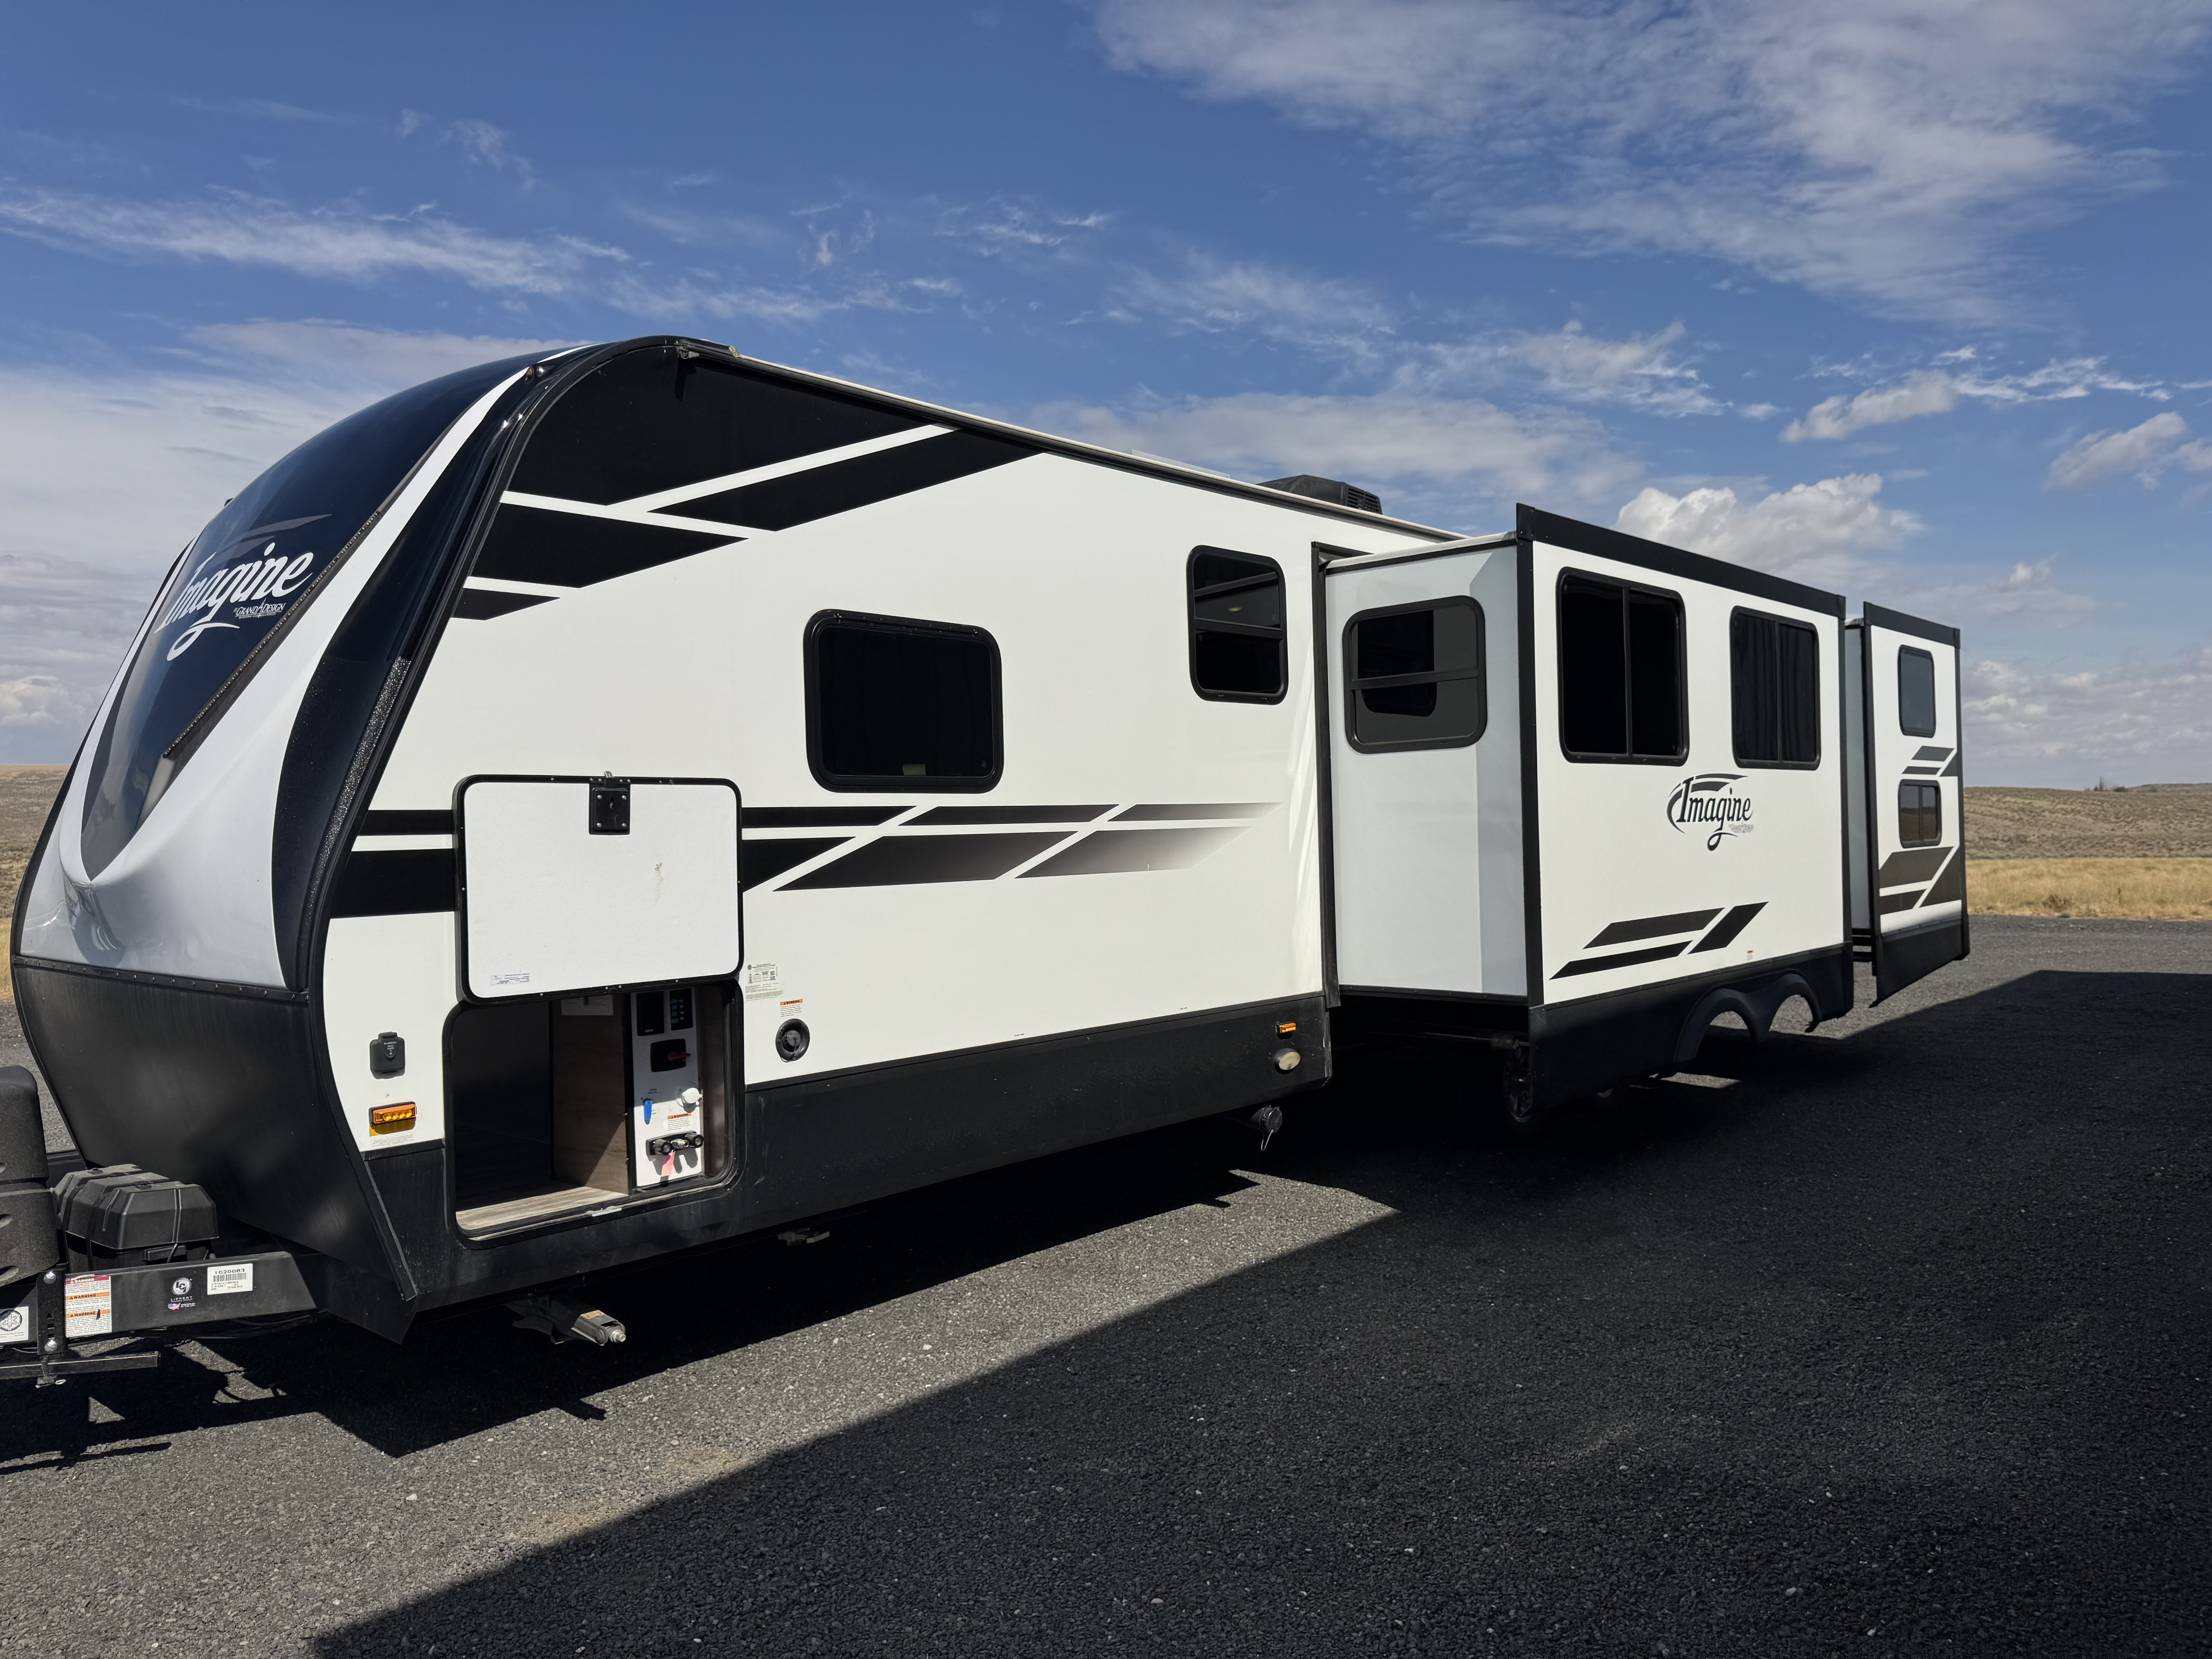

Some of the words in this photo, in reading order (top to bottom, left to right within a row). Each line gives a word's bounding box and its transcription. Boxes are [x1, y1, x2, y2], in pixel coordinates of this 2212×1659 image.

[154, 542, 314, 661] Imagine
[236, 606, 258, 616] GRAND
[262, 603, 286, 612] DESIGN
[1676, 776, 1753, 851] Imagine
